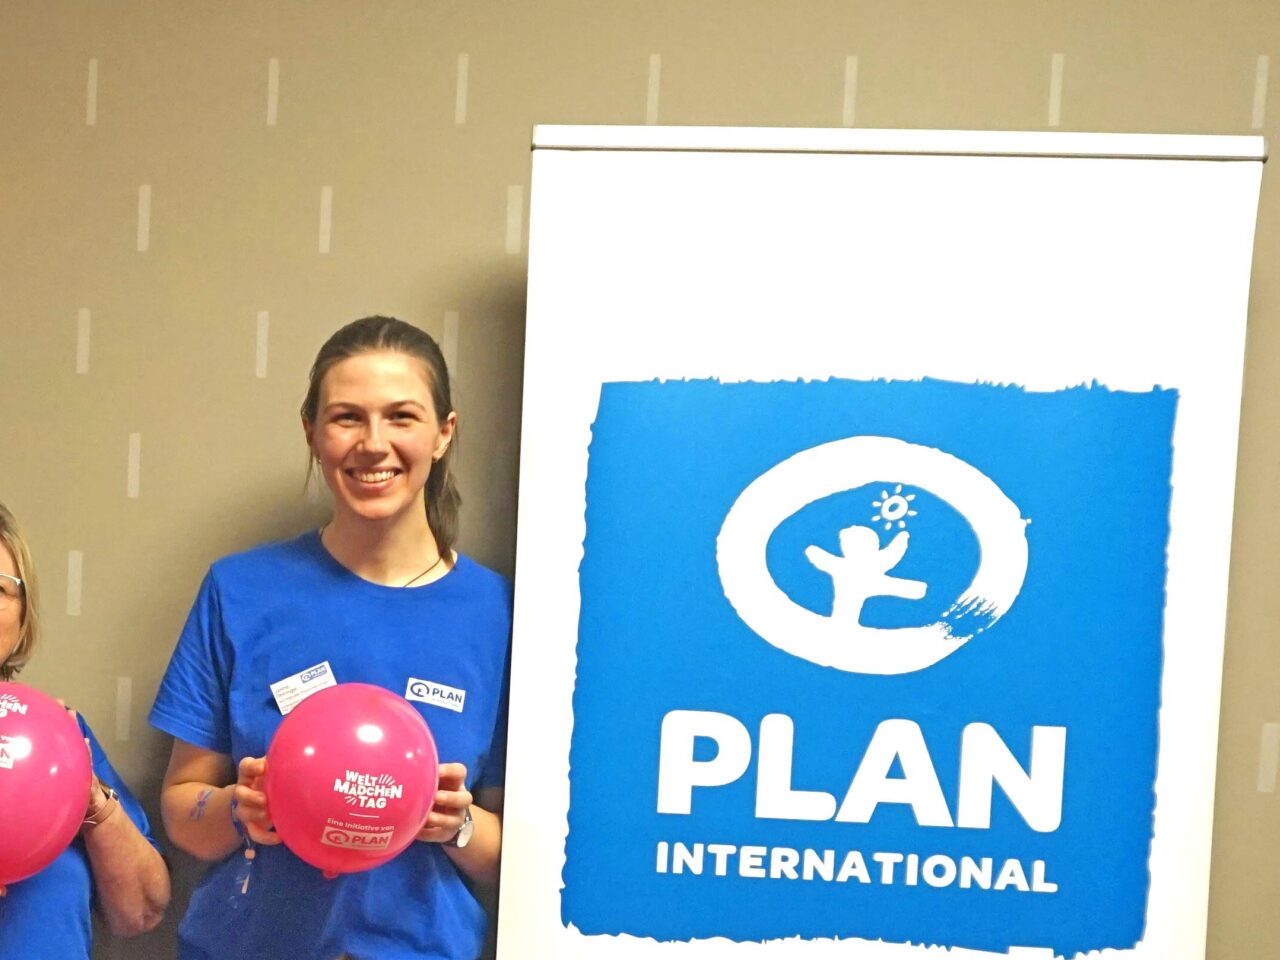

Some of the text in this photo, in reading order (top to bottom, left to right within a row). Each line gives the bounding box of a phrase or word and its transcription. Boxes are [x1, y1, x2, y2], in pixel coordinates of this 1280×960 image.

[432, 687, 463, 704] PLAN
[345, 770, 378, 786] WELT
[657, 709, 1067, 833] PLAN
[333, 778, 403, 799] MÄDCHEN
[359, 795, 387, 808] TAG
[327, 817, 344, 827] Eine
[345, 822, 380, 831] Initiative
[351, 835, 389, 845] PLAN
[656, 841, 1059, 893] INTERNATIONAL
